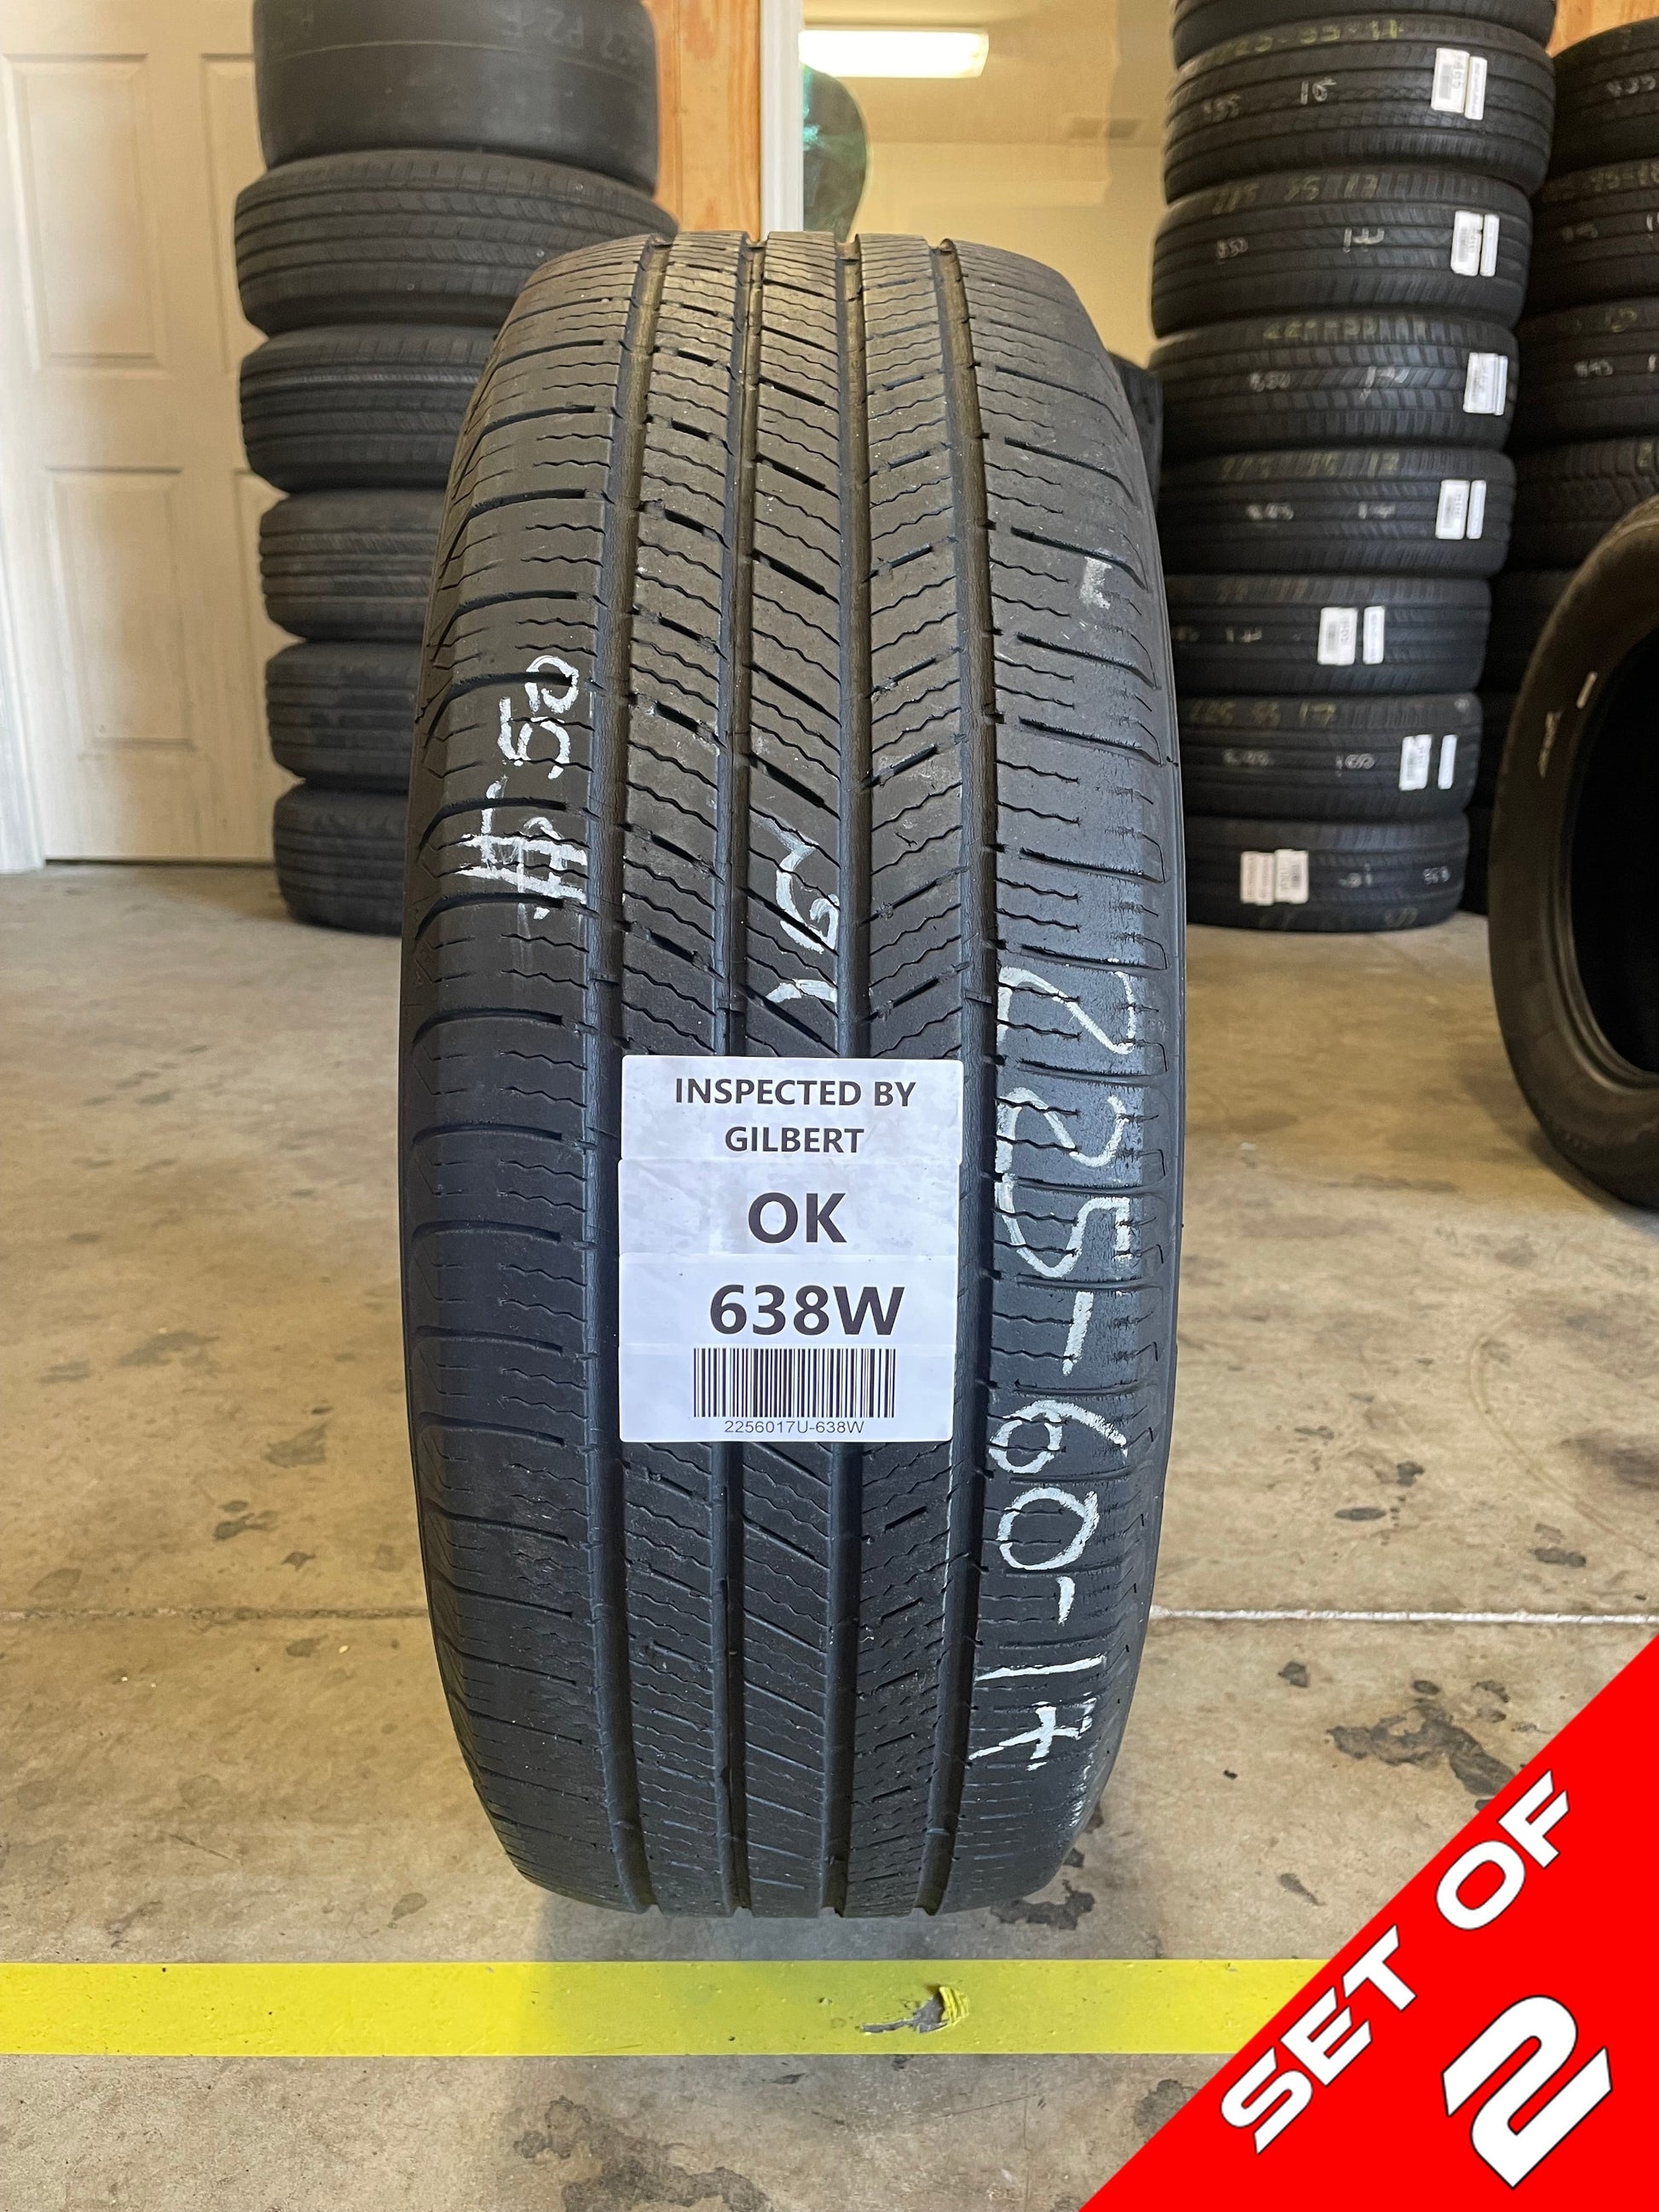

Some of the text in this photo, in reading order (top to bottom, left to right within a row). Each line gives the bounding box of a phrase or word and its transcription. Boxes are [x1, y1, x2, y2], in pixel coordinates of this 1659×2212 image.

[675, 1077, 916, 1107] INSPECTED BY
[725, 1126, 864, 1153] GILBERT
[748, 1192, 847, 1244] OK
[709, 1284, 905, 1336] 638W
[724, 1419, 865, 1435] 2256017U-638W
